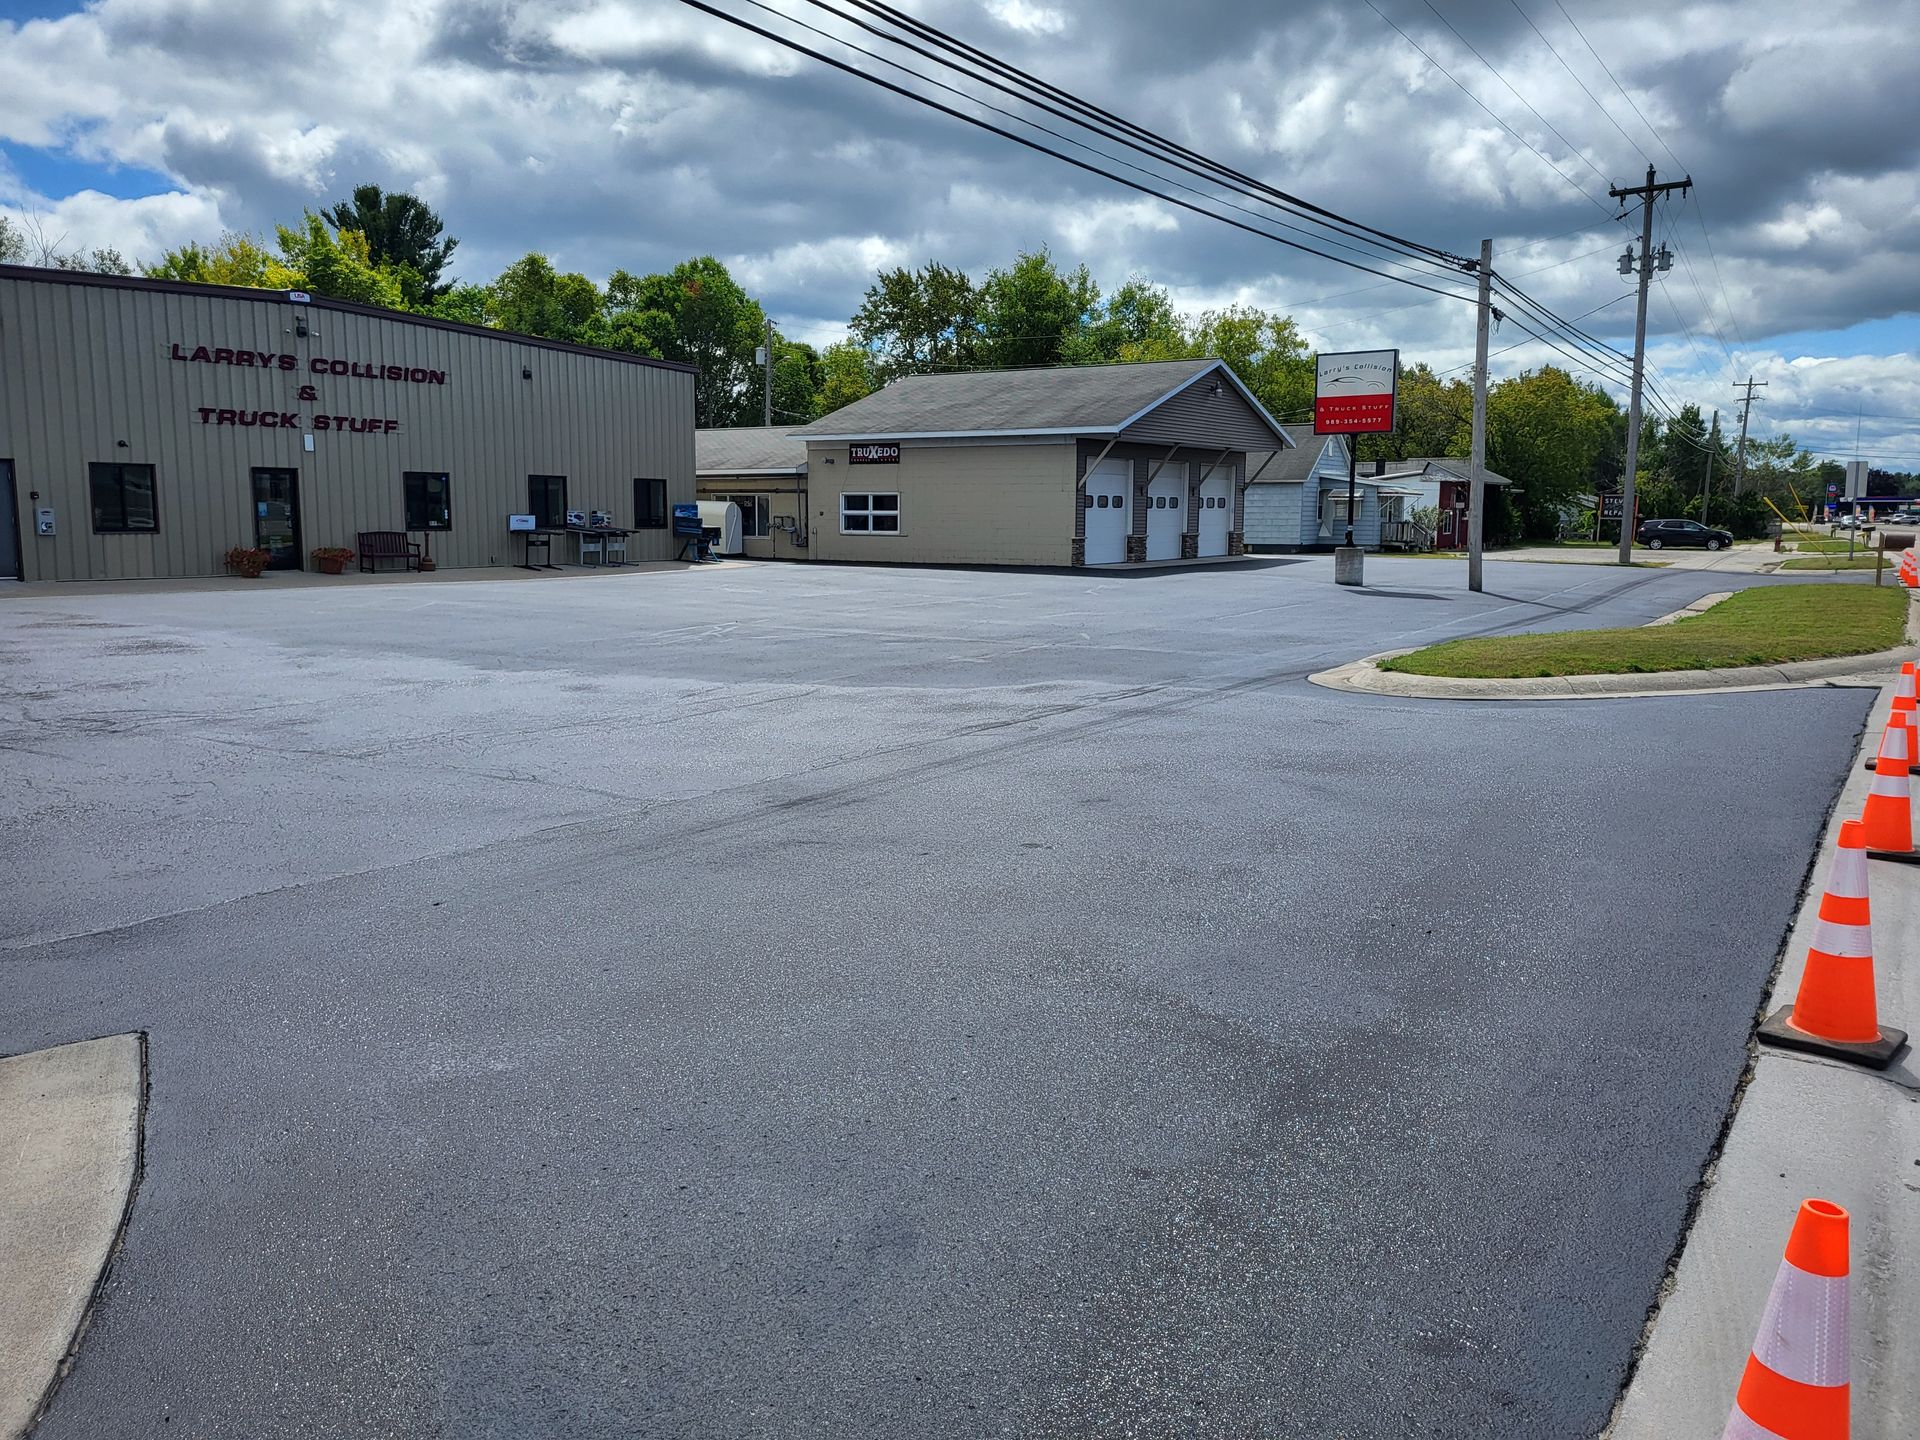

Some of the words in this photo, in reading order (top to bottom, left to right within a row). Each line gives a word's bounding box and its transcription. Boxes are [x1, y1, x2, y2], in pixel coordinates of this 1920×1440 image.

[310, 358, 446, 385] COLLISION
[1319, 365, 1350, 377] Larry's
[1354, 363, 1392, 373] Collision
[298, 384, 318, 401] &
[198, 407, 298, 429] TRUCK
[313, 415, 398, 434] STUFF
